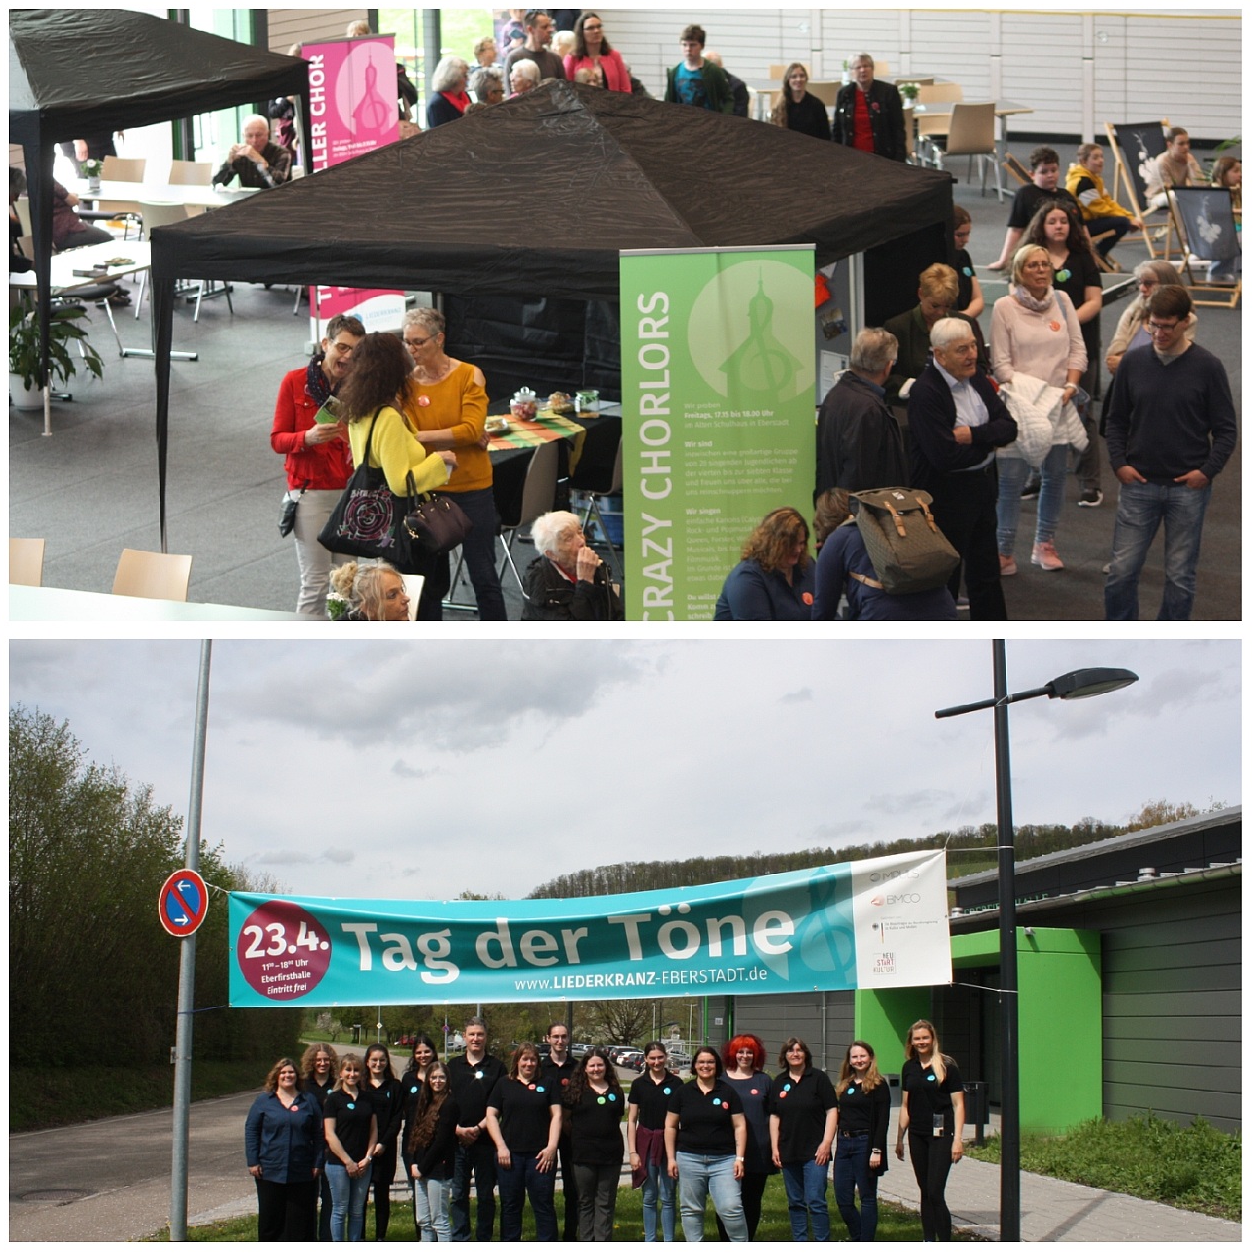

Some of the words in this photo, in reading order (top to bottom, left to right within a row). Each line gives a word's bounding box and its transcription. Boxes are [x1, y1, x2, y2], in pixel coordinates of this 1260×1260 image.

[308, 54, 327, 116] CHOR
[637, 291, 673, 500] CHORLORS
[243, 921, 330, 959] 23.4.
[341, 923, 460, 984] Tag
[475, 917, 588, 969] der
[607, 903, 795, 961] Töne
[261, 971, 311, 984] Eberfirsthalle
[295, 959, 309, 967] Uhr
[515, 966, 768, 990] www.LIEDERKRANZ-EBERSTADT.de
[267, 984, 293, 995] Eintritt
[293, 983, 307, 993] frei
